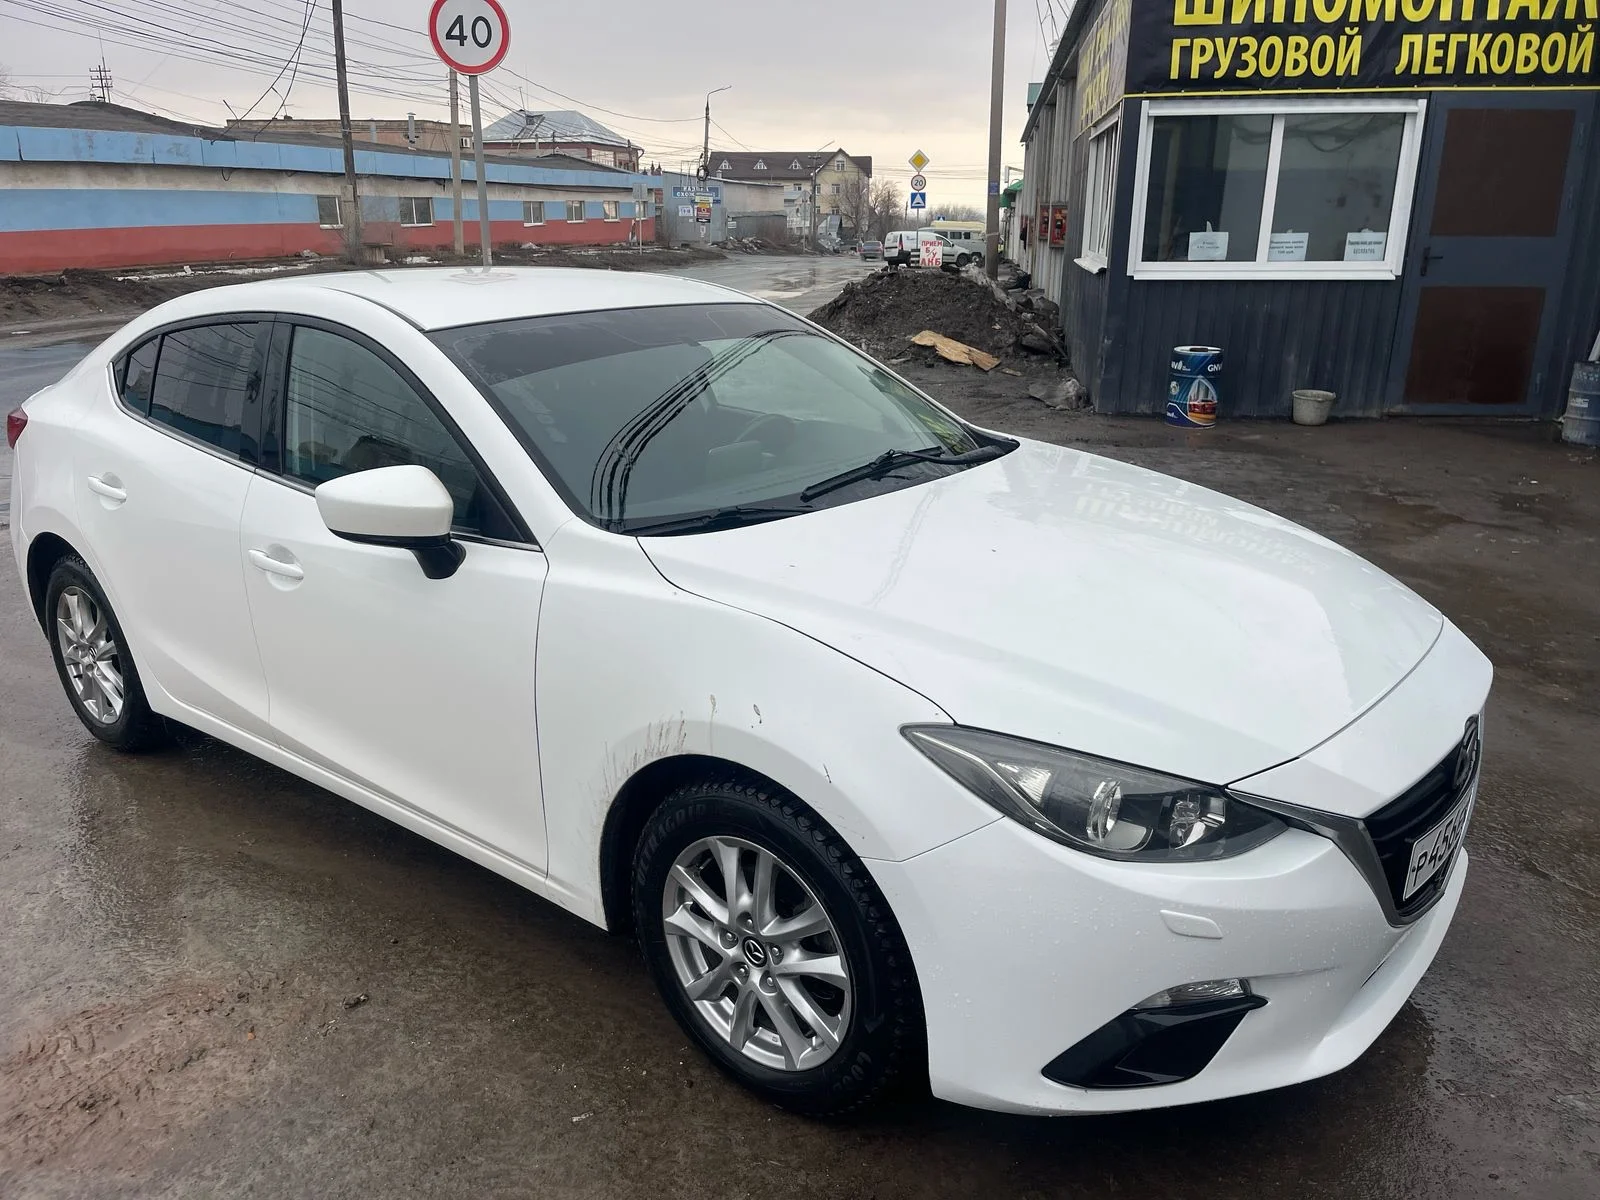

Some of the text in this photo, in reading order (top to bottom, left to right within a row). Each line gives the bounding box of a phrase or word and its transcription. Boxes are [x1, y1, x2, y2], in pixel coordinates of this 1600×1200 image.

[445, 14, 492, 48] 40
[1169, 26, 1363, 80] ГРУЗОВОЙ
[1394, 23, 1595, 75] ЛЕГКОВОЙ
[914, 179, 924, 187] 20
[920, 258, 941, 266] АКБ
